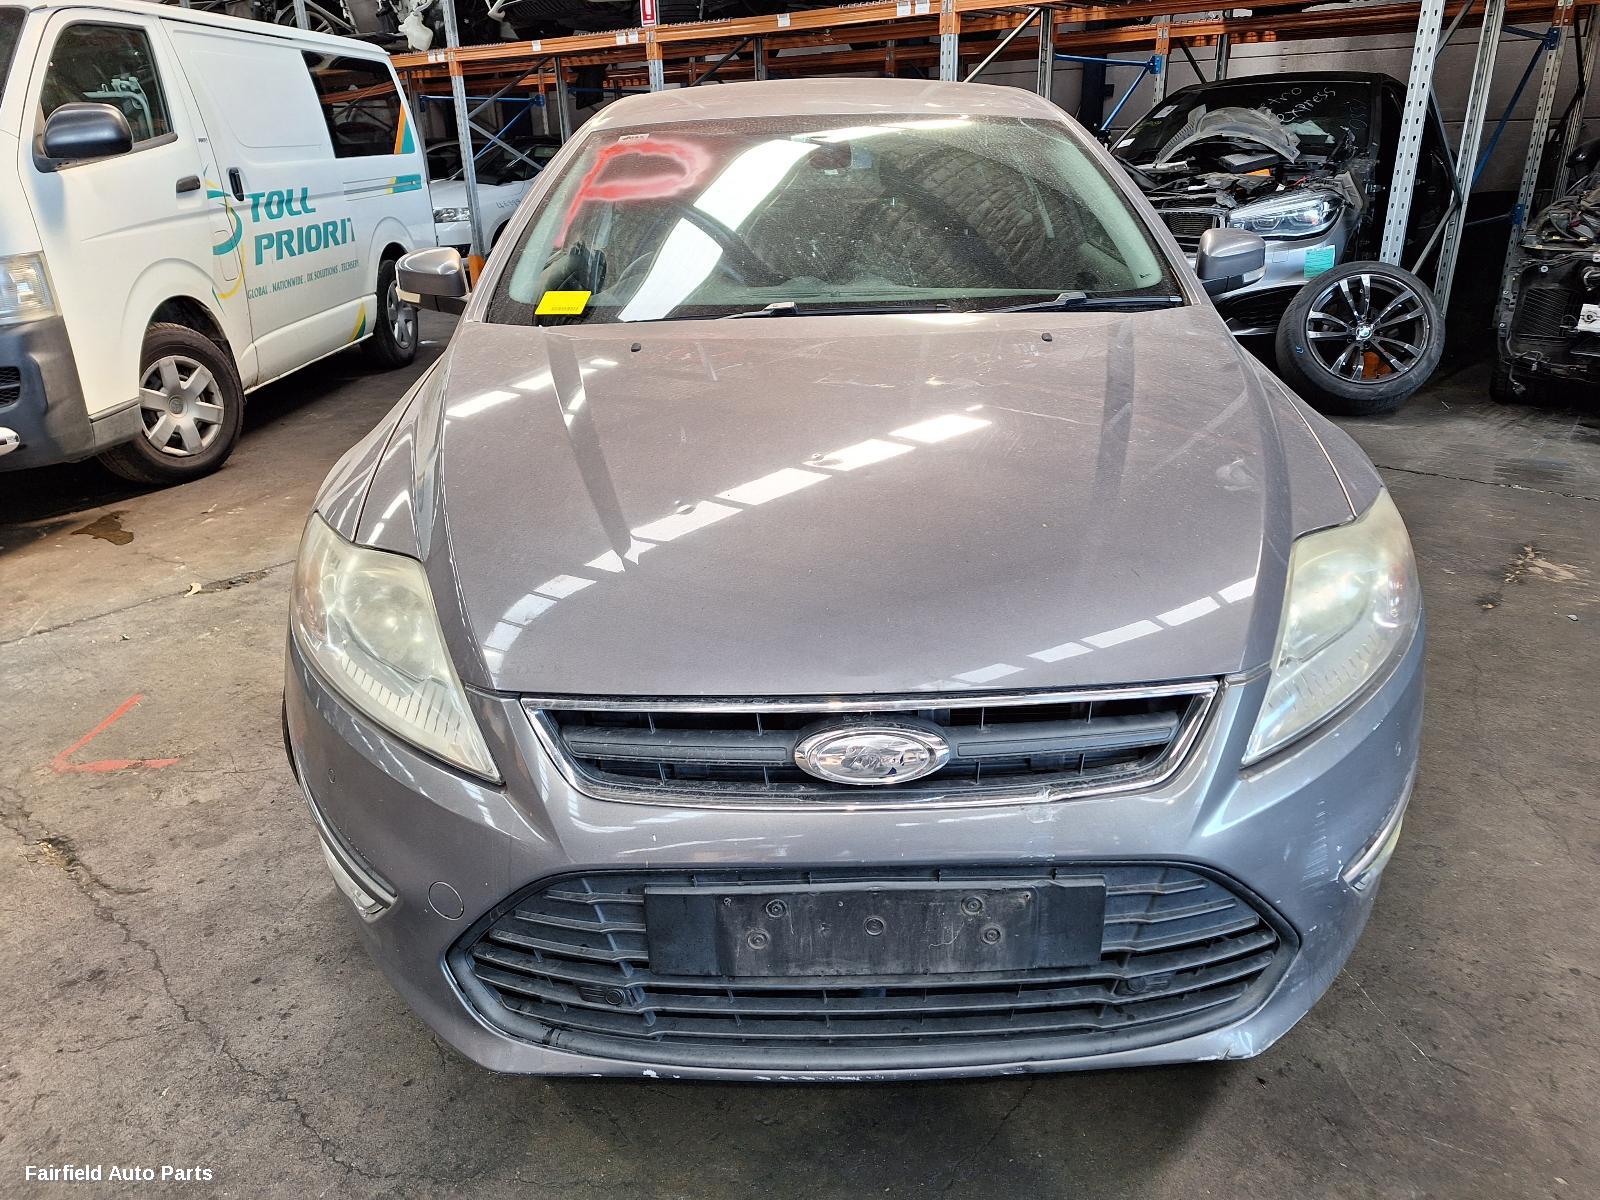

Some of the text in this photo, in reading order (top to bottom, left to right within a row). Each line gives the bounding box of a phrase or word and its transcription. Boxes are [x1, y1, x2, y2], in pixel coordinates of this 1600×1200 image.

[245, 187, 316, 222] TOLL
[554, 138, 712, 248] P
[247, 285, 269, 300] GLOBAL
[272, 274, 304, 293] NATIONWIDE
